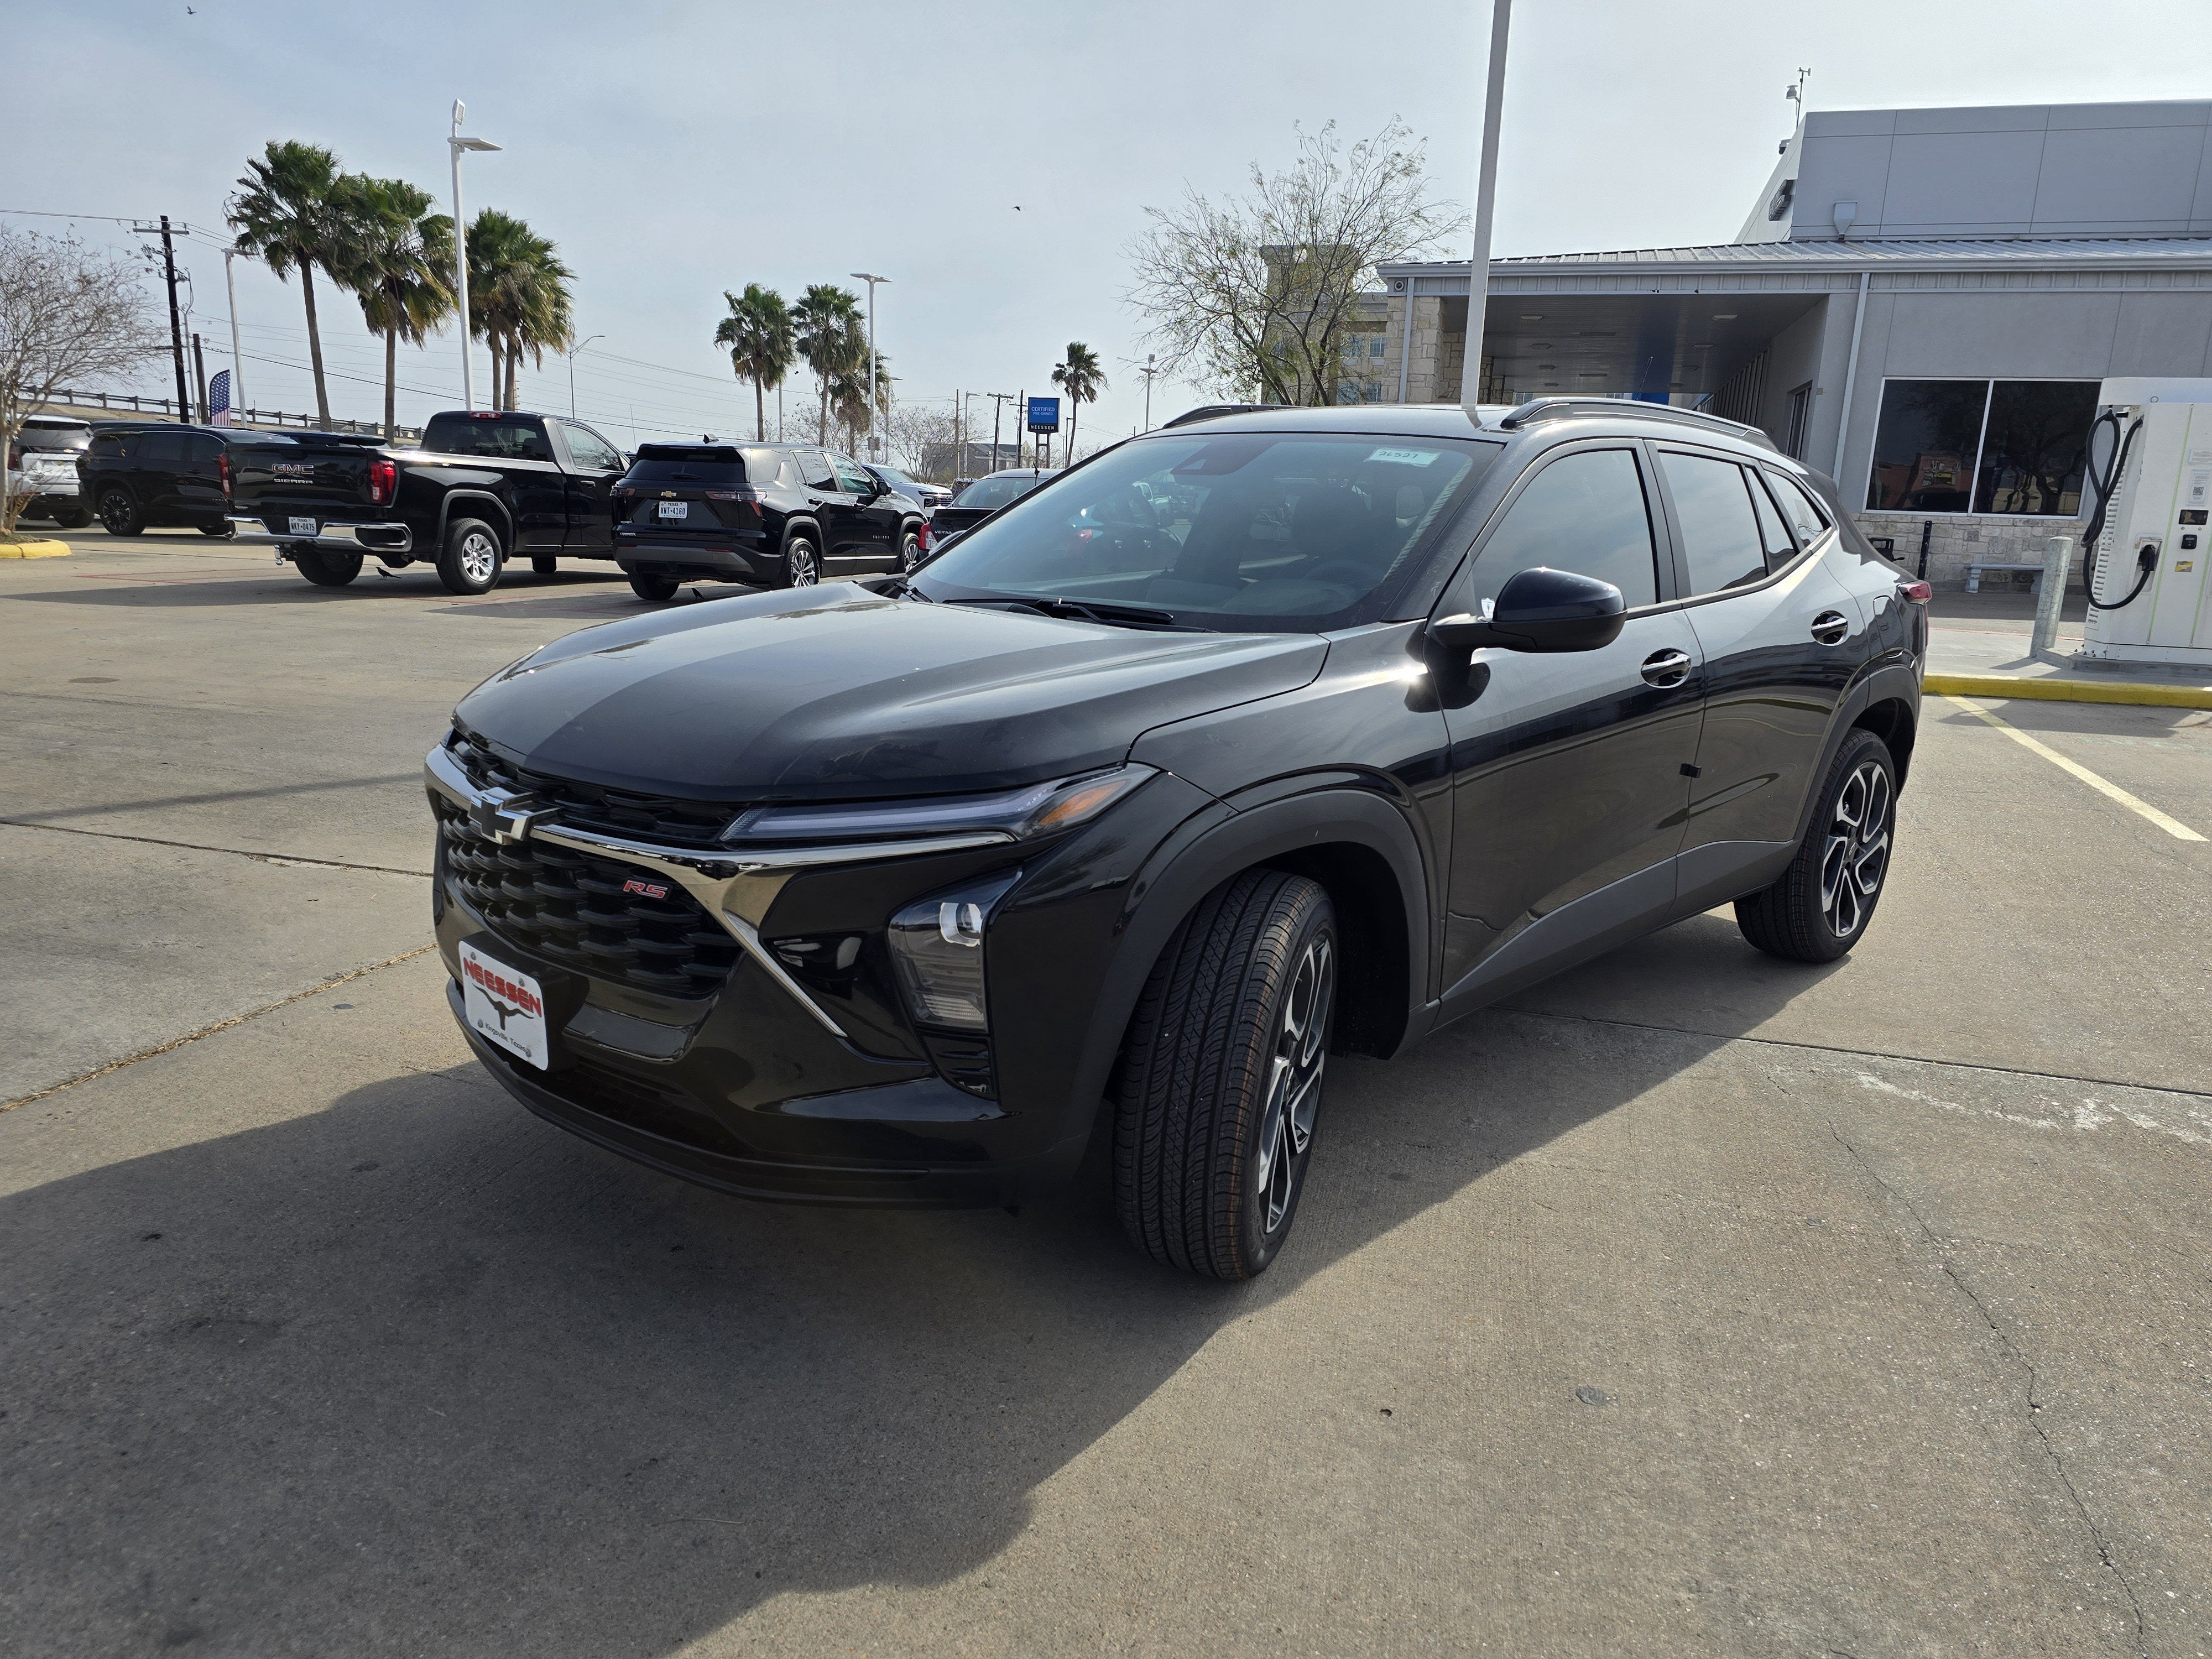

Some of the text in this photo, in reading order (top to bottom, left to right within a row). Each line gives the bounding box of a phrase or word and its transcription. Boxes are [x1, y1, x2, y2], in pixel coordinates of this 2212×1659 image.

[1379, 451, 1419, 459] 26527
[272, 463, 314, 474] GMC
[623, 880, 668, 899] RS
[463, 957, 542, 1018] NEESSEN
[510, 1037, 526, 1052] Texas
